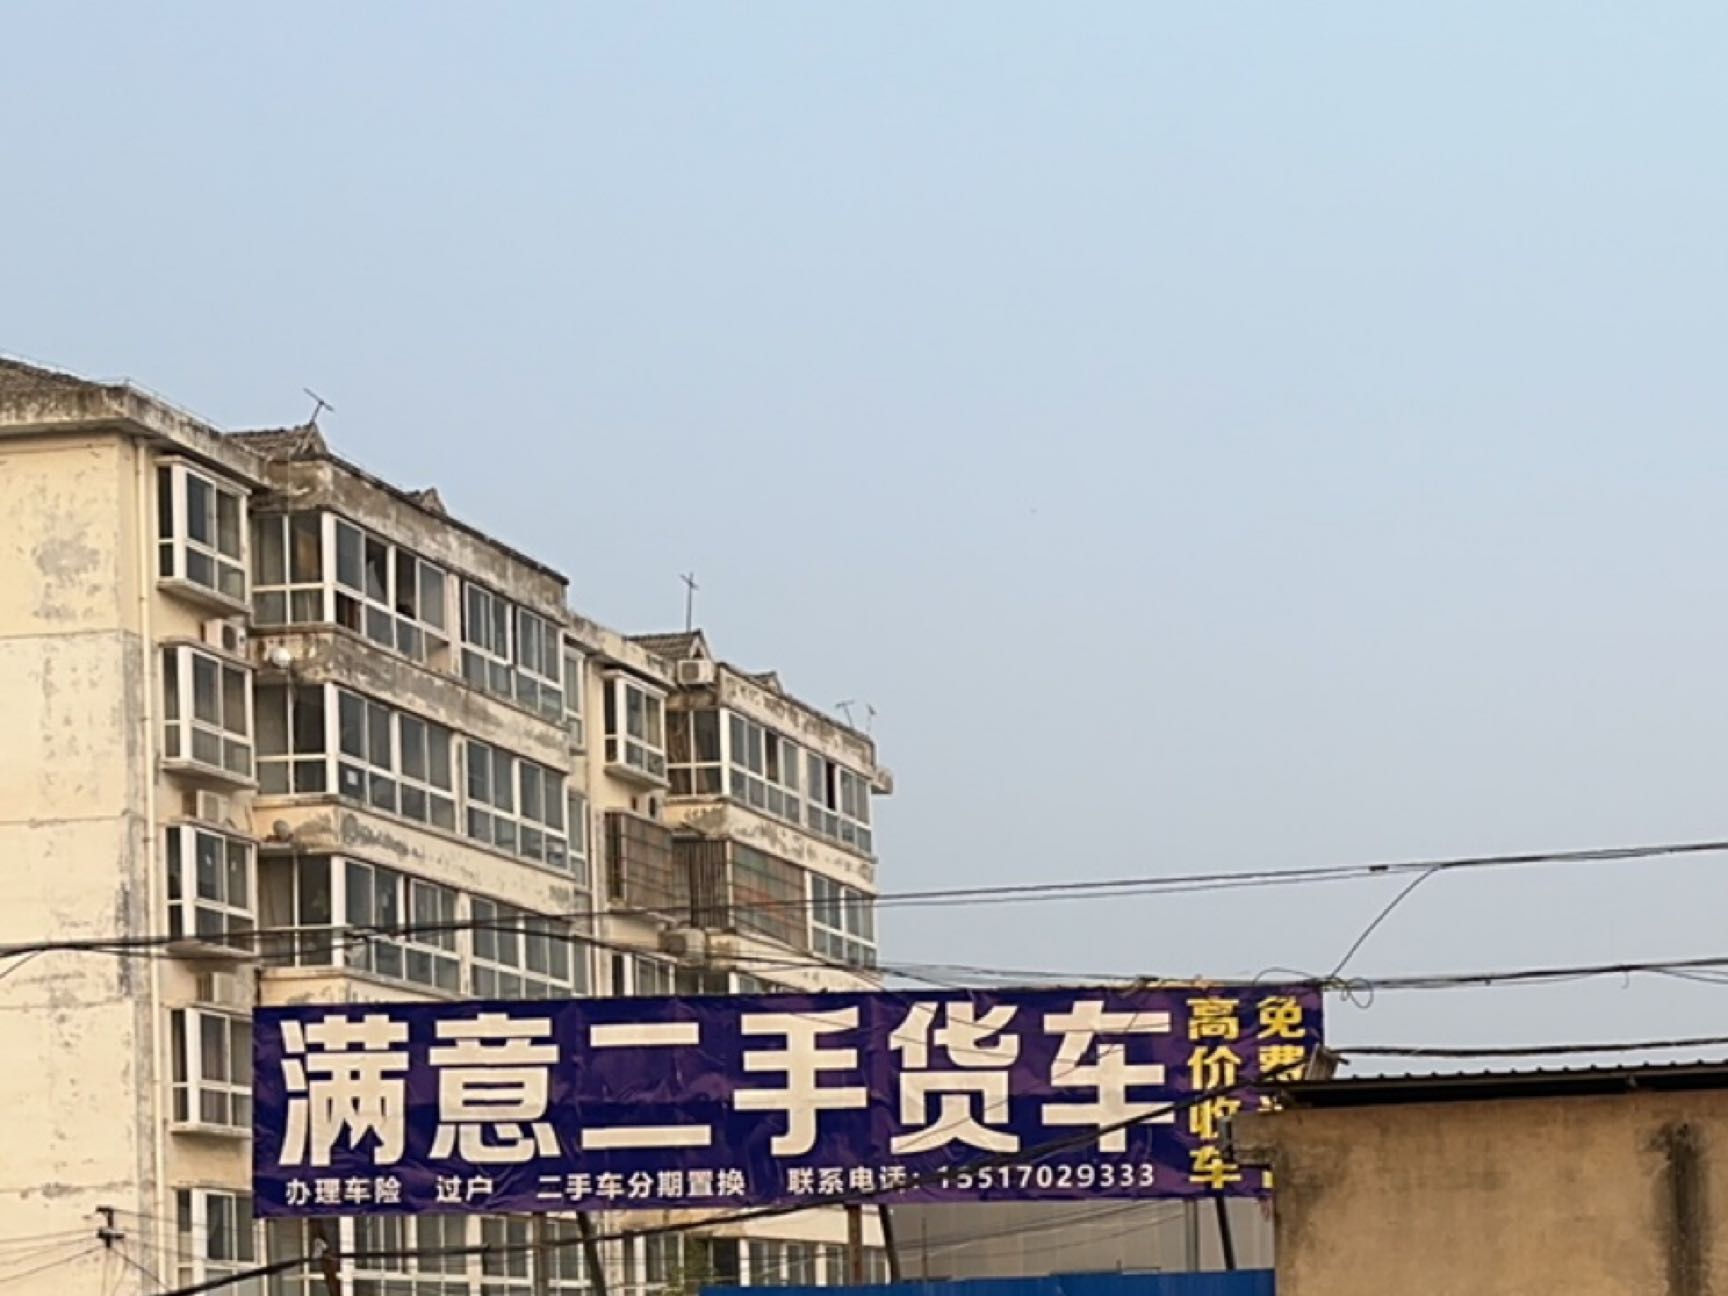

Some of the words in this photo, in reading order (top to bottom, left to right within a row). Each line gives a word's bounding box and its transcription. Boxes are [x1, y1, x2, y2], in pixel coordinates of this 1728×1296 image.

[279, 1000, 1175, 1166] 满意二手货车
[1187, 996, 1242, 1189] 高价收车
[285, 1176, 402, 1206] 办理车险
[435, 1175, 495, 1203] 过户
[537, 1169, 746, 1200] 二手车分期置换
